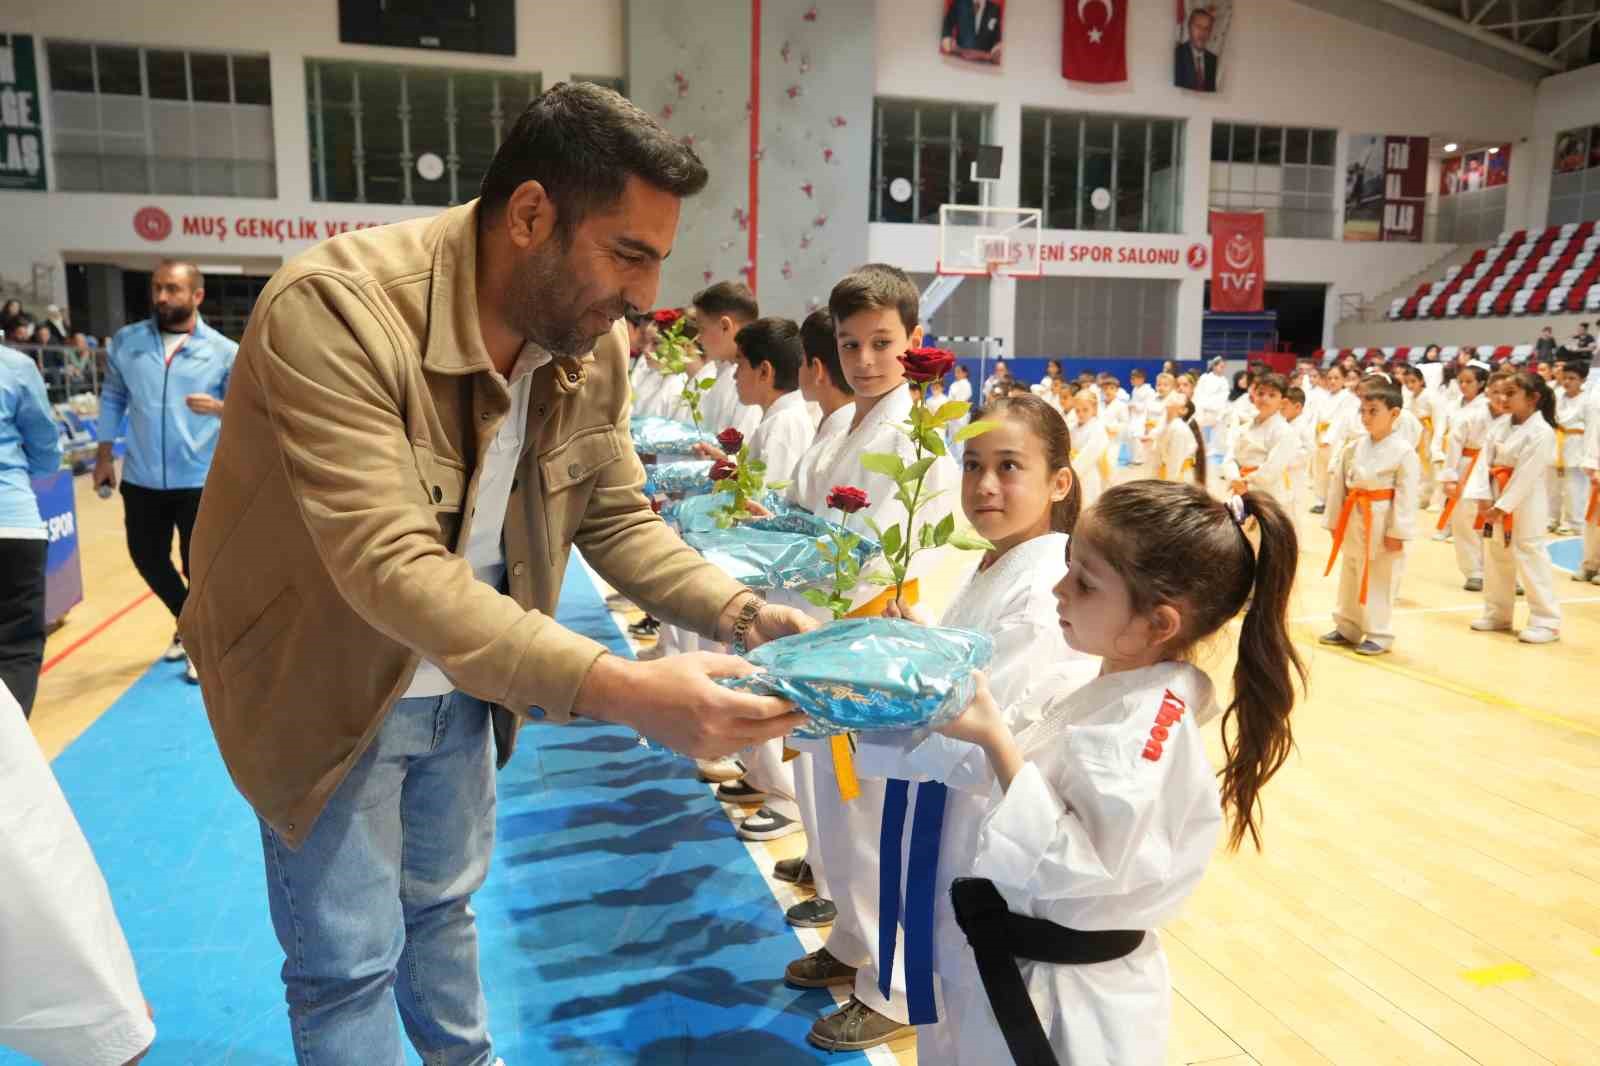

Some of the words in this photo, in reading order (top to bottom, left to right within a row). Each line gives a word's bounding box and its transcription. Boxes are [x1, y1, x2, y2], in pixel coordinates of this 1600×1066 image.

[181, 216, 227, 241] MUŞ
[235, 217, 318, 243] GENÇLİK
[1027, 240, 1064, 261] YENİ
[1069, 245, 1112, 263] SPOR
[1117, 246, 1180, 265] SALONU
[1219, 271, 1258, 291] TVF
